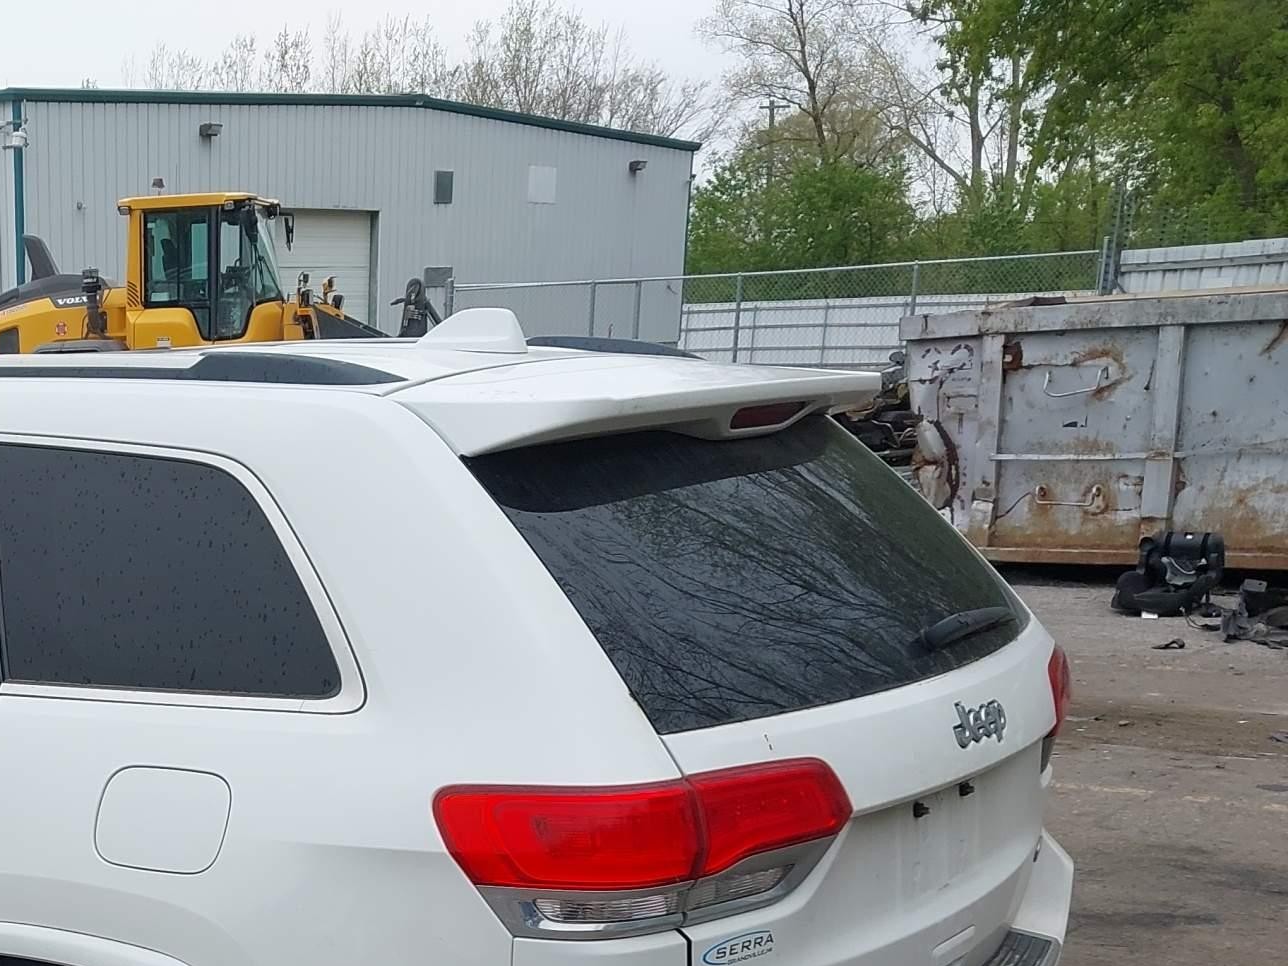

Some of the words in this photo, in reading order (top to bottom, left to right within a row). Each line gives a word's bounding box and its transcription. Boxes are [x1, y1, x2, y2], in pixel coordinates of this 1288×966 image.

[55, 294, 99, 306] VOLV
[953, 699, 1007, 749] Jeep
[715, 933, 774, 960] SERRA
